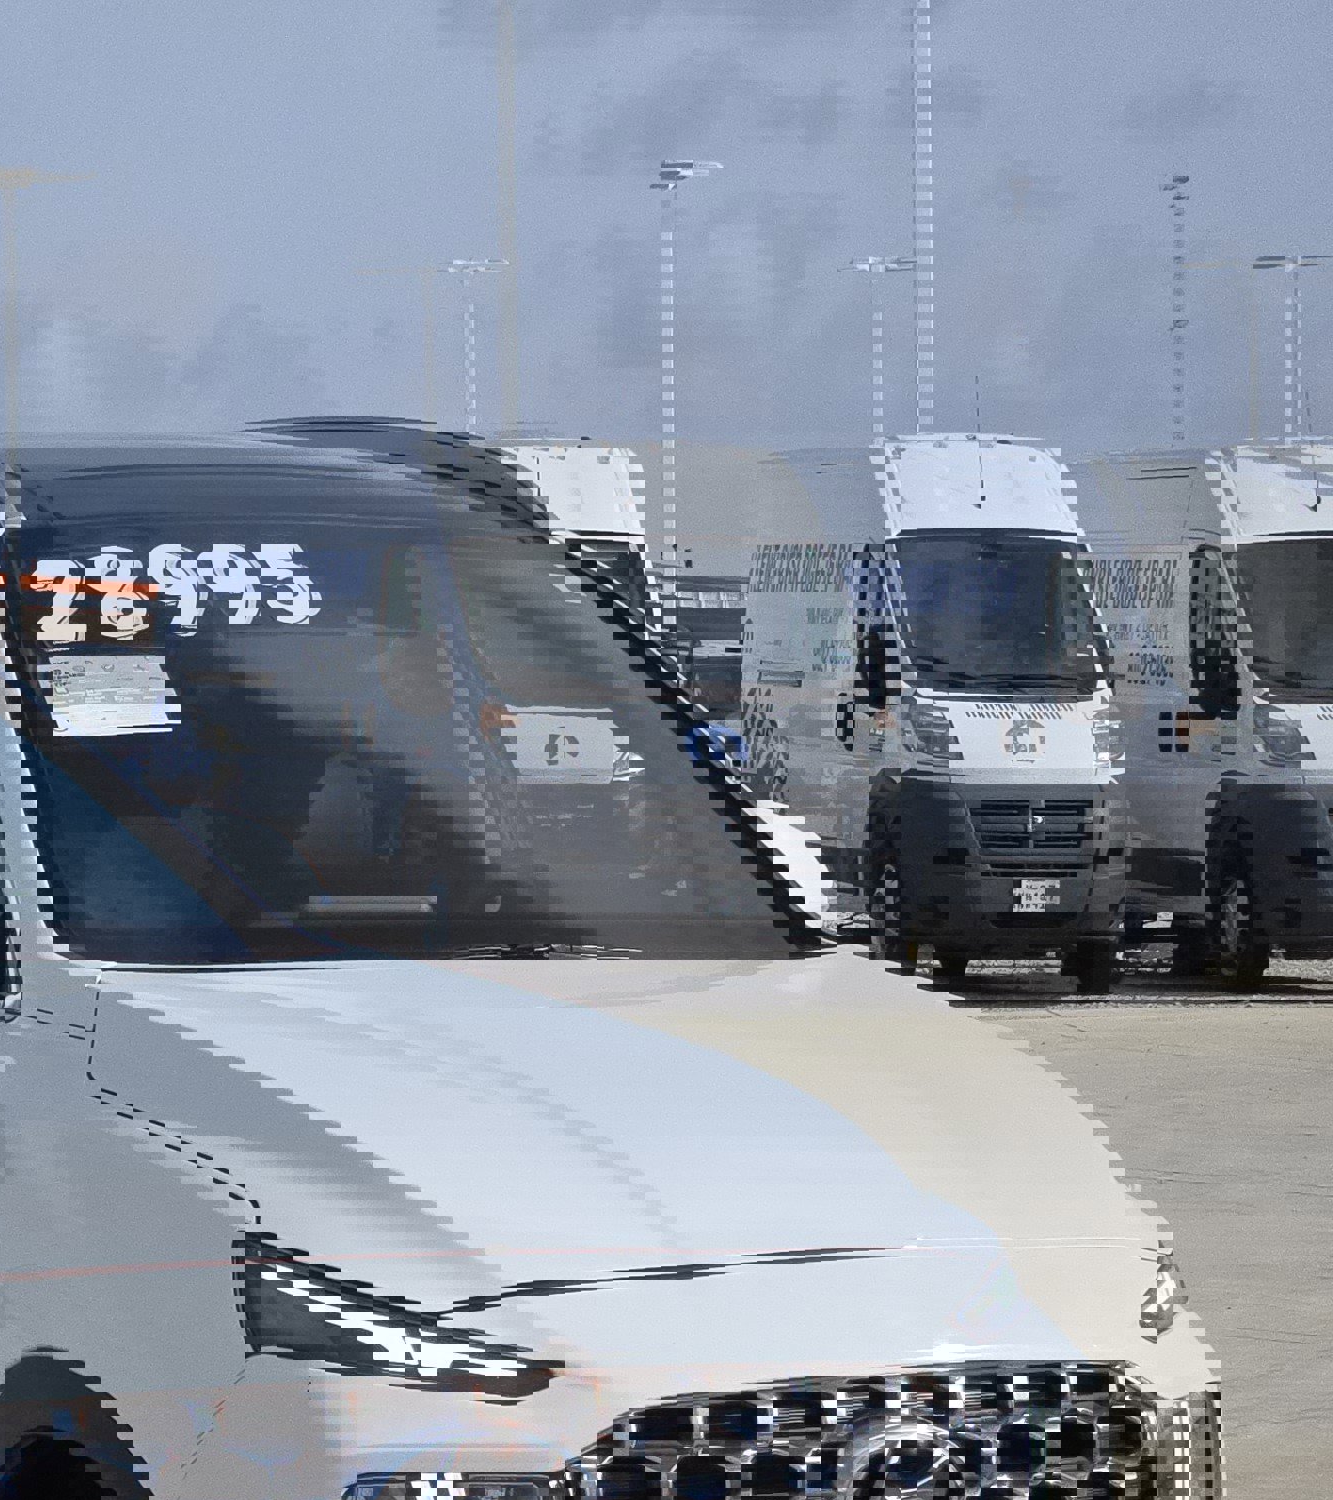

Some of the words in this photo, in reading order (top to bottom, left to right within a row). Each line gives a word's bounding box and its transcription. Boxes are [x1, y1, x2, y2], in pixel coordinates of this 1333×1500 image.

[171, 551, 220, 596] KLEMENT
[218, 551, 274, 597] CHRYSLER
[272, 551, 311, 597] DODGE
[309, 551, 340, 597] JEEP
[337, 550, 369, 597] RAM
[904, 563, 951, 613] DODGE
[949, 564, 982, 614] JEEP
[983, 563, 1018, 615] RAM
[689, 767, 751, 776] MOPAR
